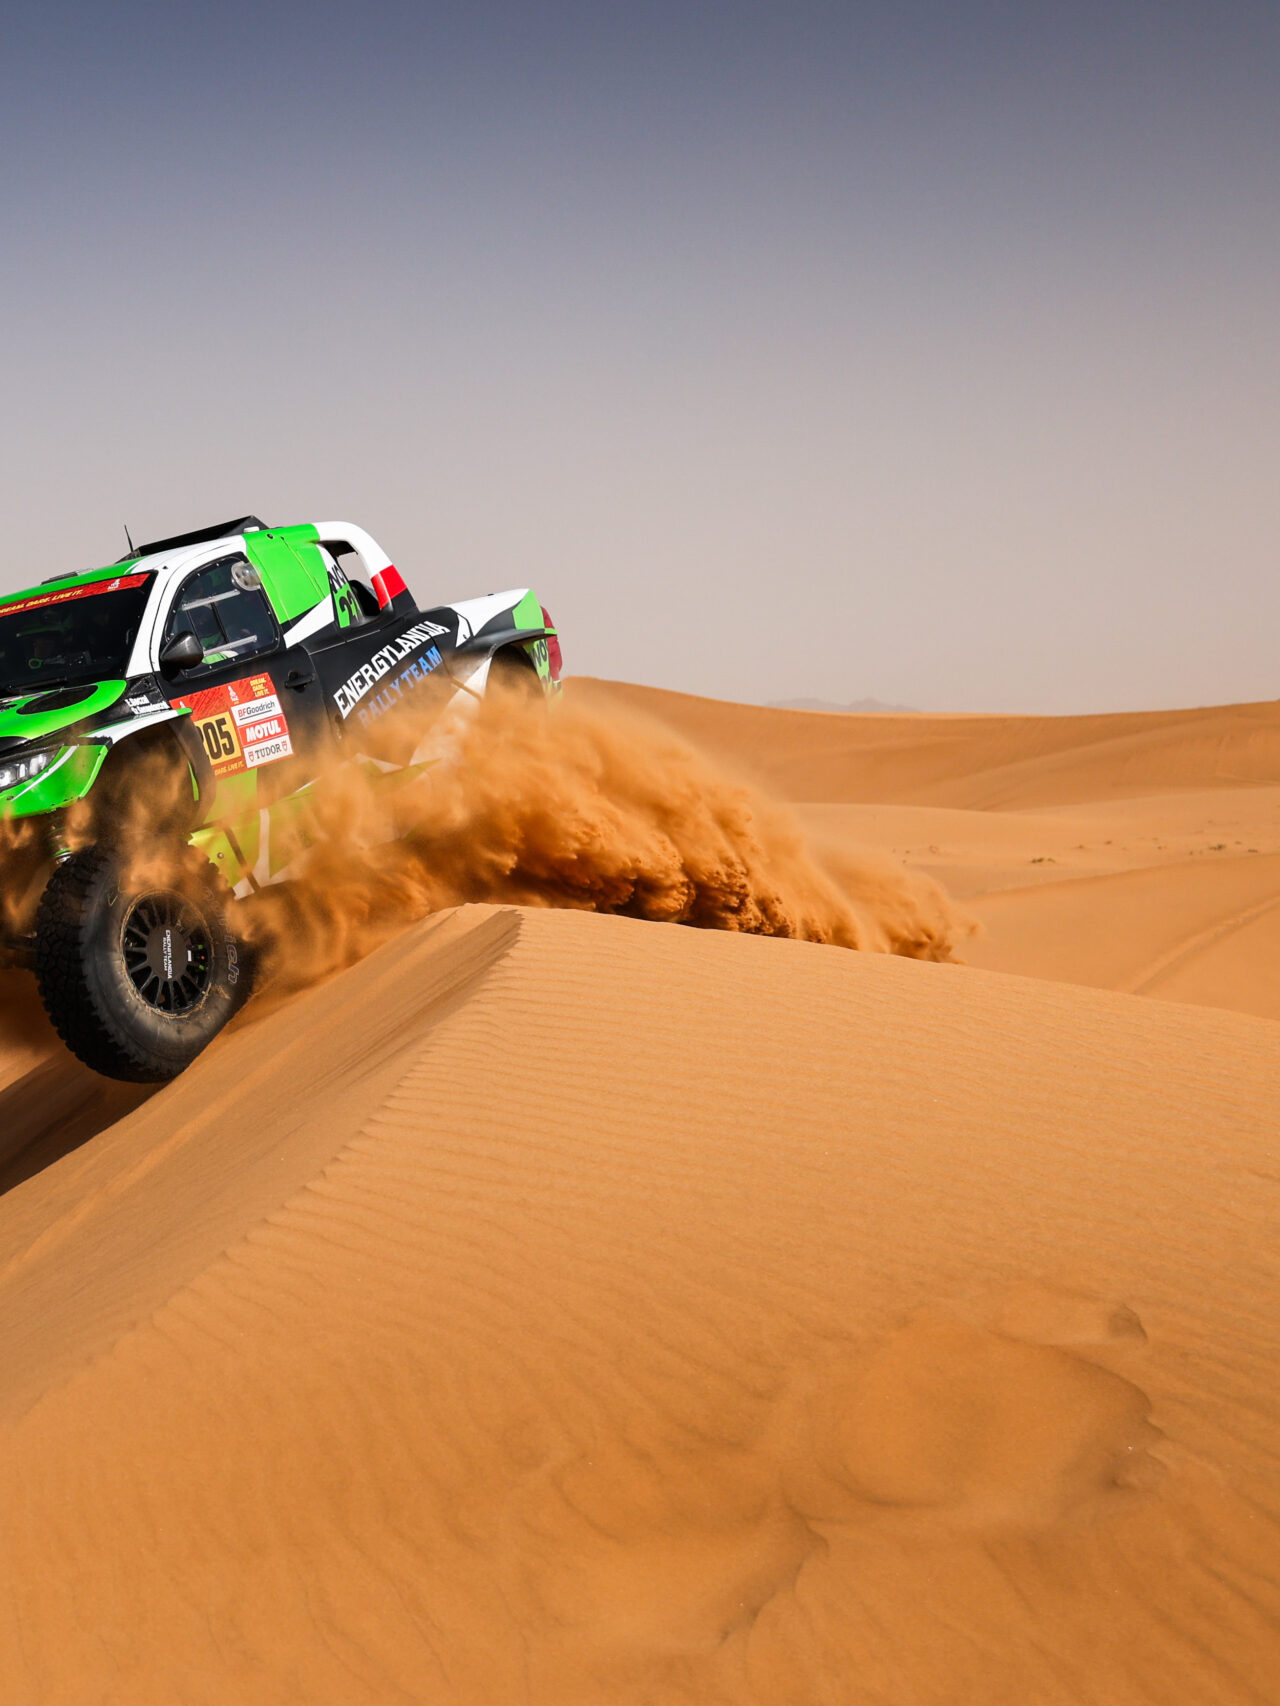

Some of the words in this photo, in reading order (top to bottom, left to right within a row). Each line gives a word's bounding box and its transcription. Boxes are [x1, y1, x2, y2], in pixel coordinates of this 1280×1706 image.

[26, 597, 51, 607] DARE.
[52, 592, 73, 601] LIVE
[357, 678, 404, 728] RALLY
[400, 646, 444, 689] TEAM
[238, 701, 275, 718] BFGoodrich
[246, 720, 282, 743] MOTUL
[255, 743, 282, 760] TUDOR
